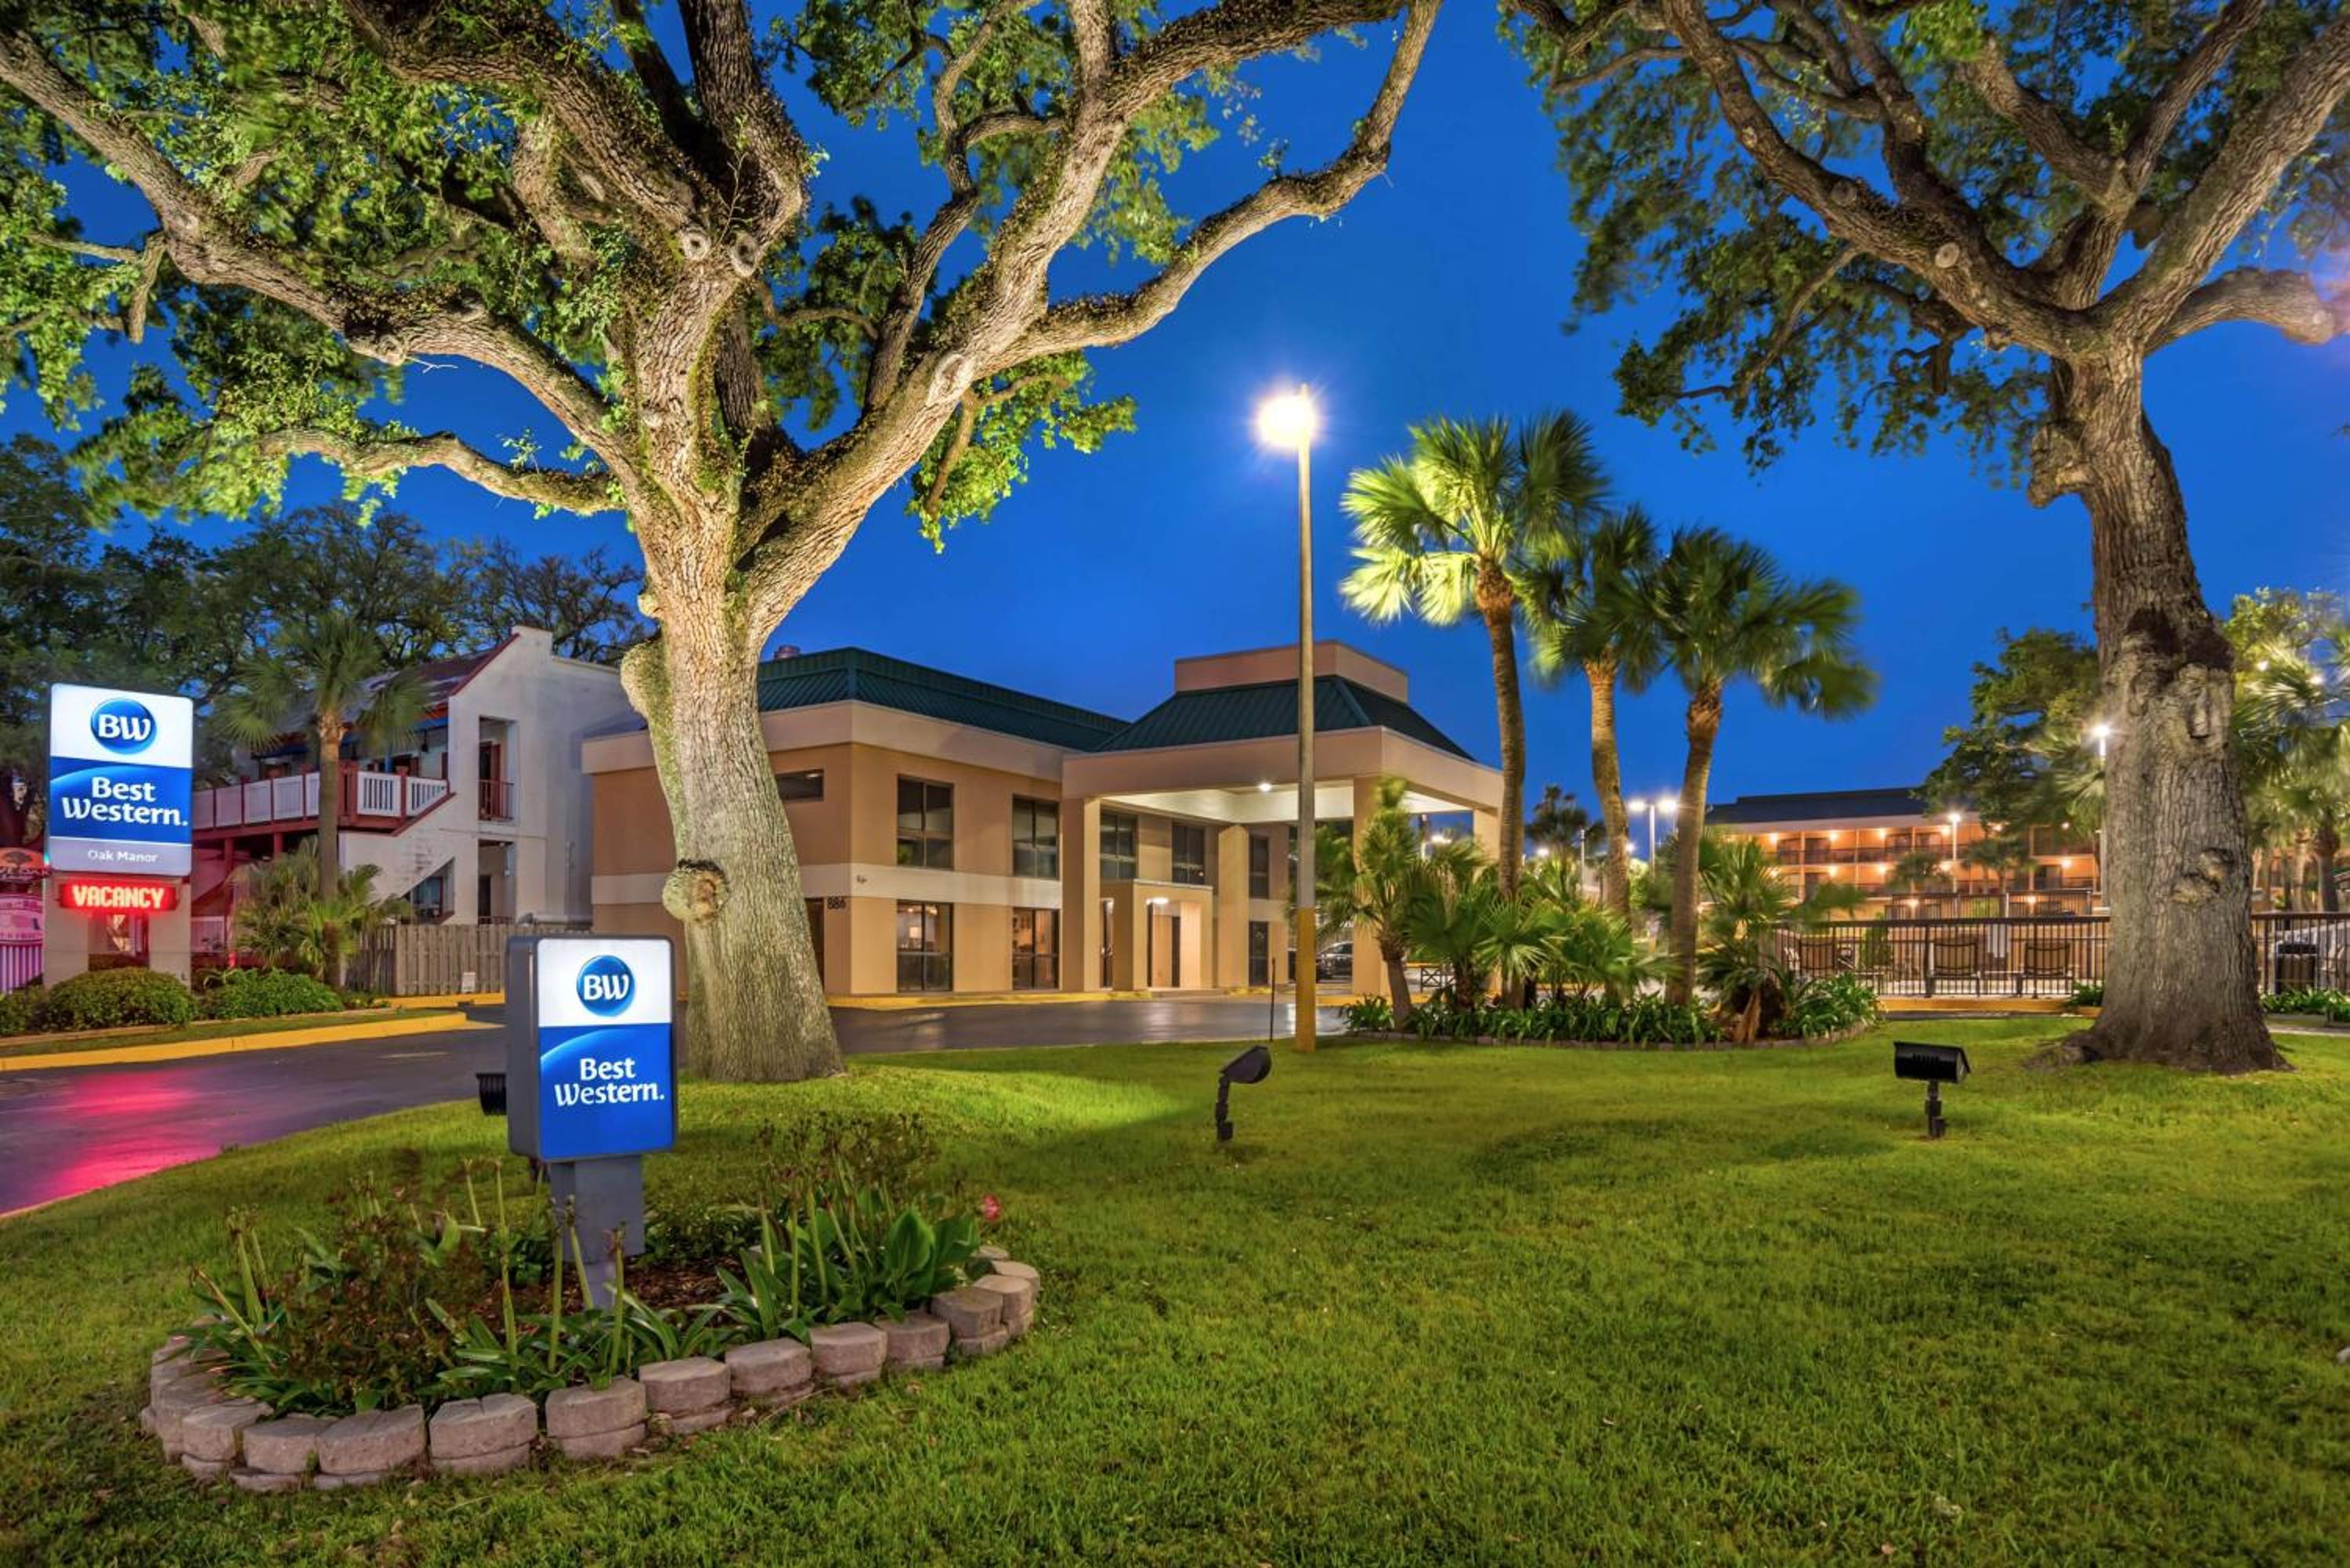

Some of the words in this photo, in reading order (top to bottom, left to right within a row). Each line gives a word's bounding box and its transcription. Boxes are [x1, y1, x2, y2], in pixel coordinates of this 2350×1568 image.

[98, 714, 151, 742] BW
[92, 776, 156, 803] Best
[88, 850, 114, 861] Oak
[117, 851, 158, 862] Manor
[72, 885, 164, 909] VACANCY
[583, 974, 630, 1001] BW
[580, 1057, 635, 1081] Best
